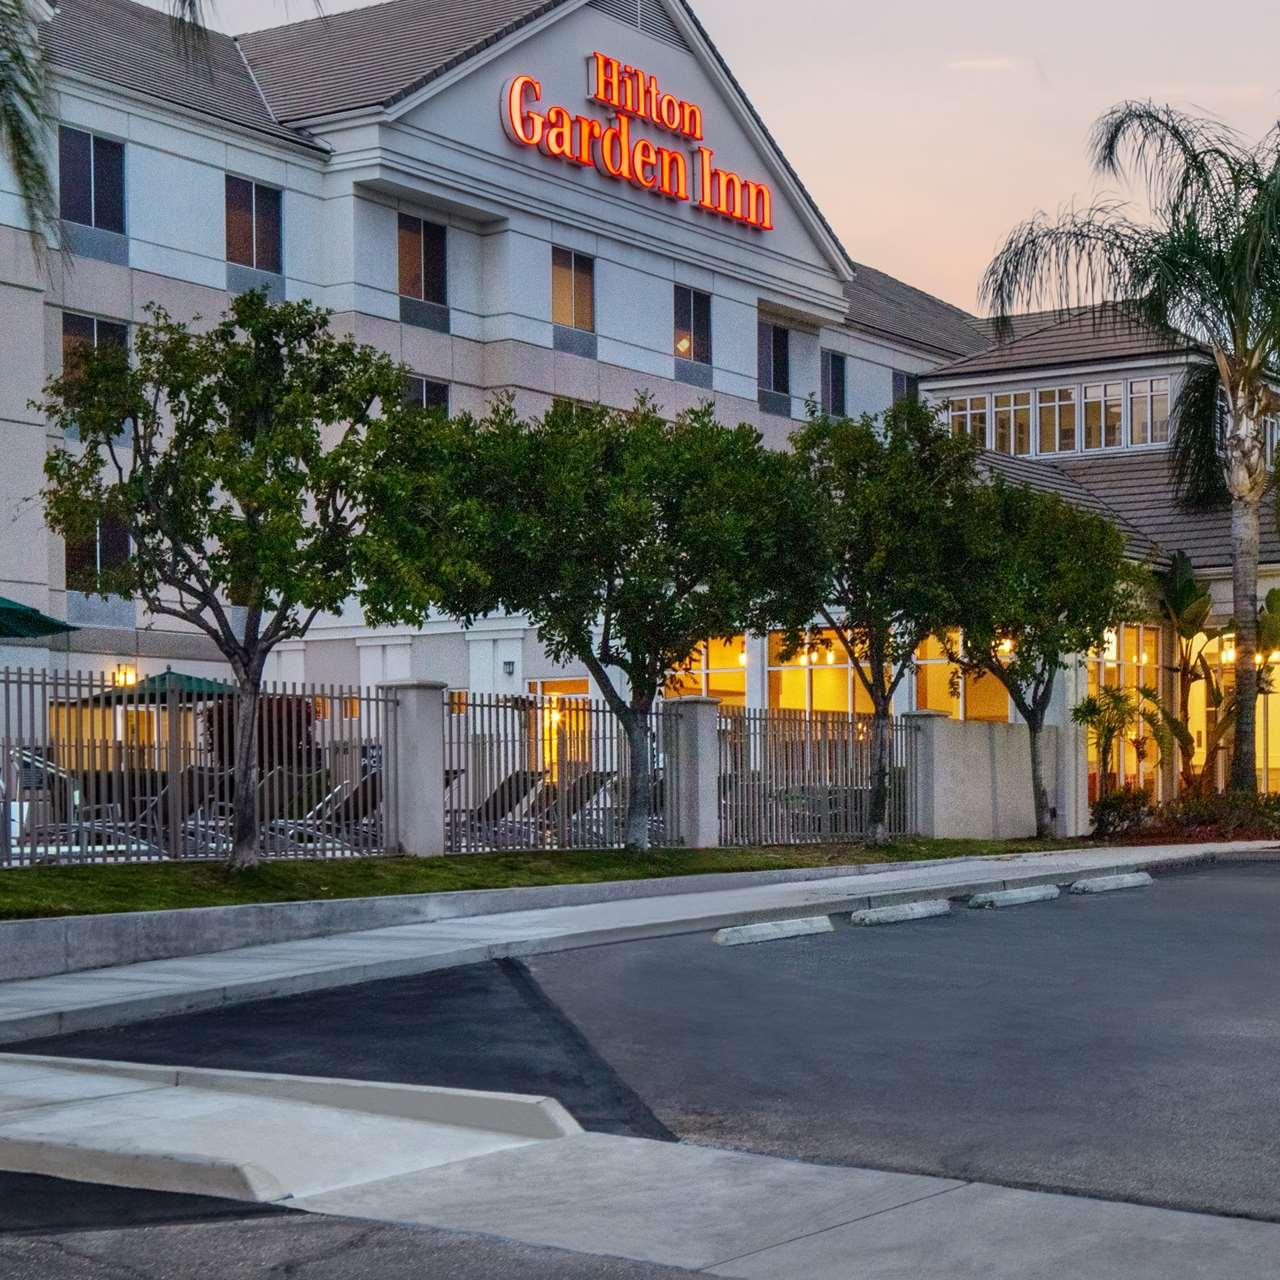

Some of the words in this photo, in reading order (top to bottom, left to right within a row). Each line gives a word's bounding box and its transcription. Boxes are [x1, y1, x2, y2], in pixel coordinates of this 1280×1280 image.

[504, 75, 690, 202] Garden
[696, 146, 774, 231] Inn
[591, 51, 704, 142] Hilton
